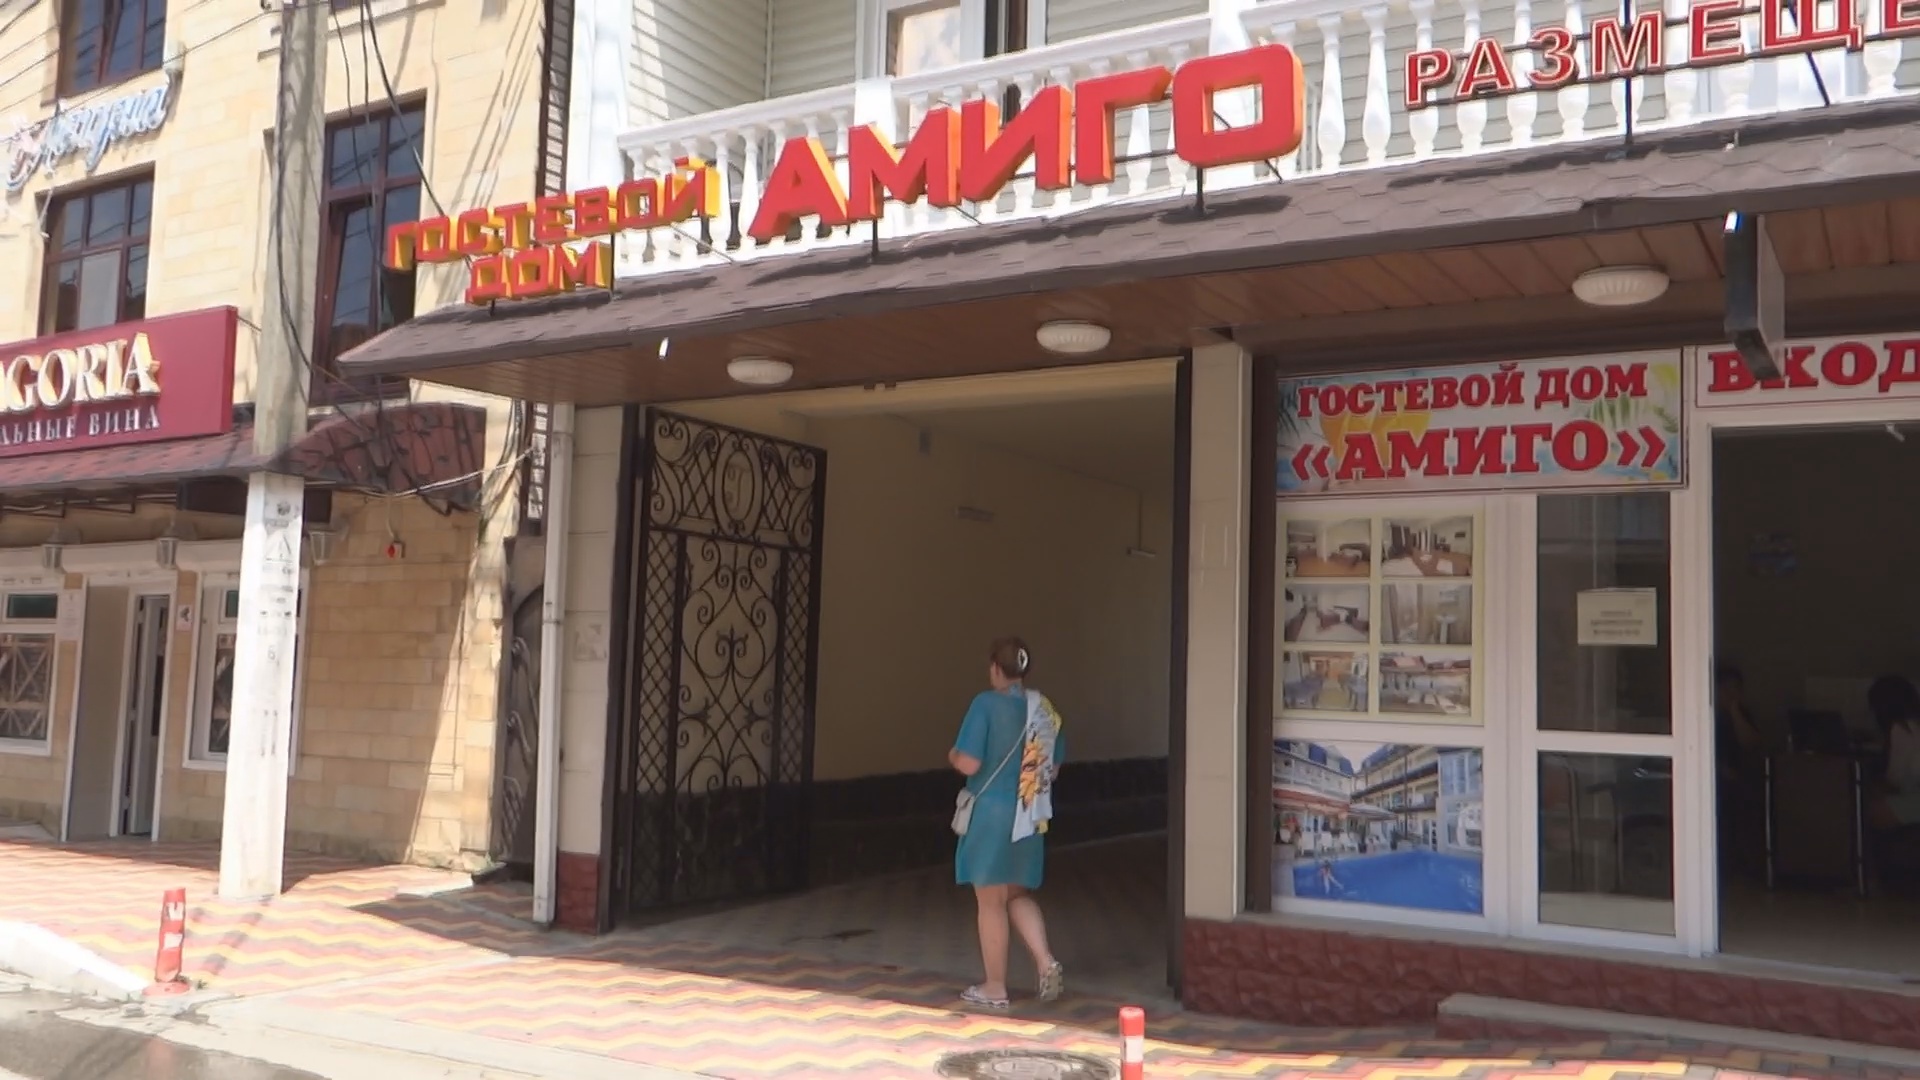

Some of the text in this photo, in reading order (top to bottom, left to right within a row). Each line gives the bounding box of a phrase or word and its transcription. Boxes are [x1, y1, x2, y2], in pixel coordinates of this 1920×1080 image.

[747, 43, 1304, 240] АМИГО
[387, 156, 720, 270] ГОСТЕВОЙ
[465, 241, 614, 304] ДОМ
[89, 404, 160, 436] ВИНА
[1297, 362, 1649, 418] ГОСТЕВОЙ ДОМ
[1291, 419, 1666, 481] «АМИГО»
